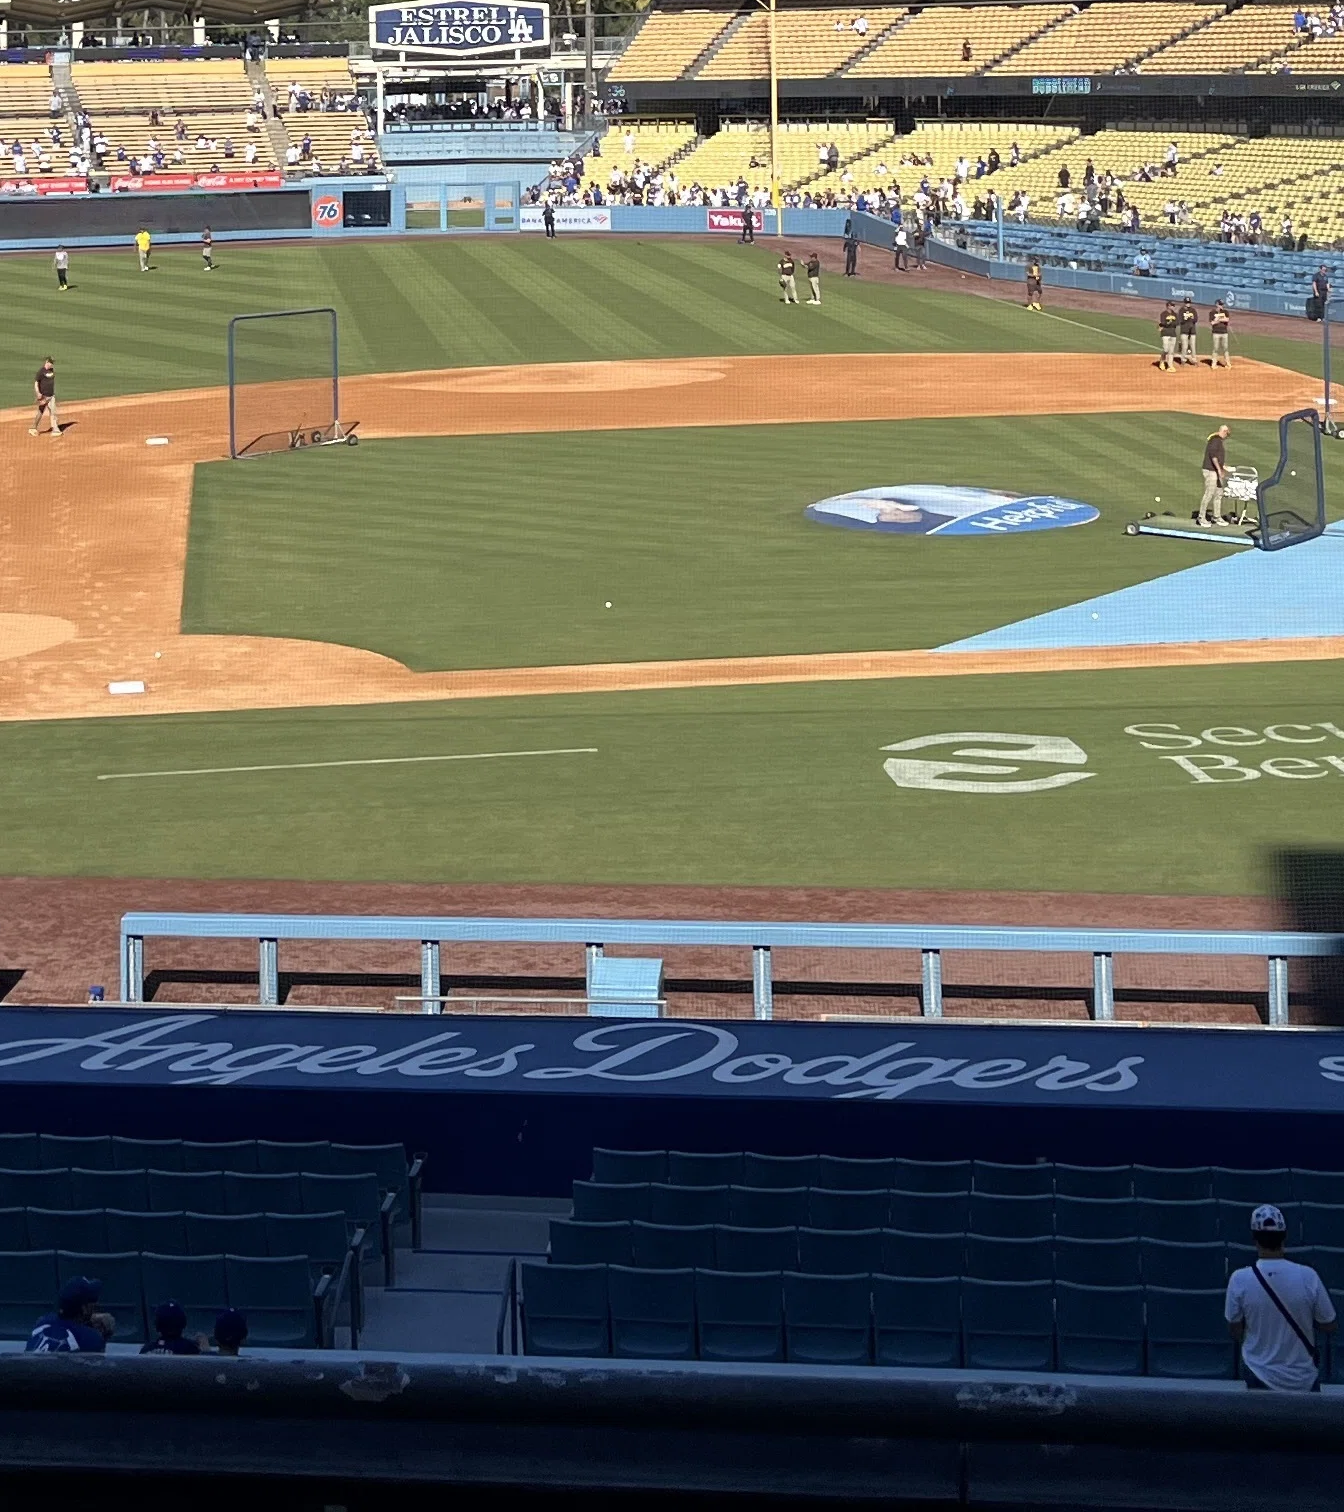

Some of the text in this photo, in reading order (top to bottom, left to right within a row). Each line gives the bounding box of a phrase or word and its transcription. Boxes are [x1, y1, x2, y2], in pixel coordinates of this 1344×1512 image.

[387, 25, 502, 45] JALISCO
[318, 202, 339, 219] 76
[709, 214, 761, 228] Yakut
[522, 1022, 1147, 1100] Dodgers
